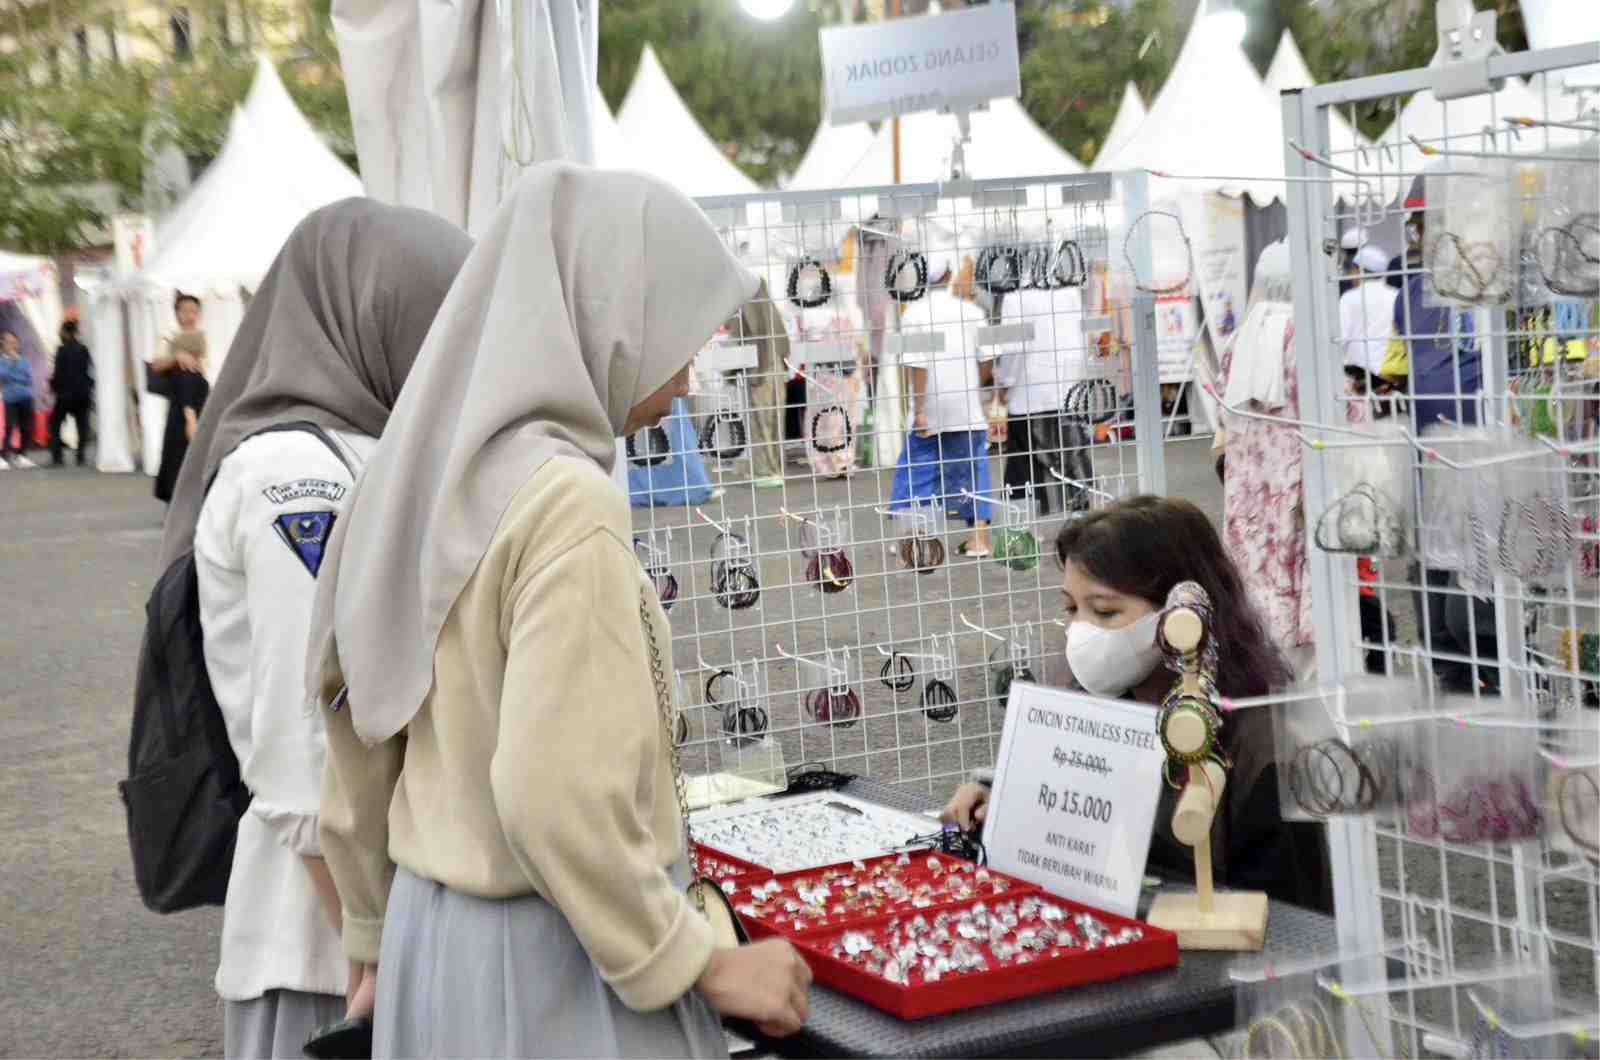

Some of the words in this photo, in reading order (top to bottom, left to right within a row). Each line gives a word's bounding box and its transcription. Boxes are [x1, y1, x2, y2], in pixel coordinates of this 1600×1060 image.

[1027, 707, 1064, 730] CINCIN
[1064, 716, 1120, 742] STAINLESS
[1123, 728, 1156, 750] STEEL
[1052, 746, 1067, 768] Rp
[1038, 784, 1056, 812] Rp
[1060, 790, 1112, 823] 15.000
[1045, 832, 1066, 846] ANTI
[1066, 838, 1096, 857] KARAT
[1017, 849, 1041, 868] TIDAK
[1041, 856, 1082, 880] BERUBAH
[1083, 872, 1119, 891] WARNA
